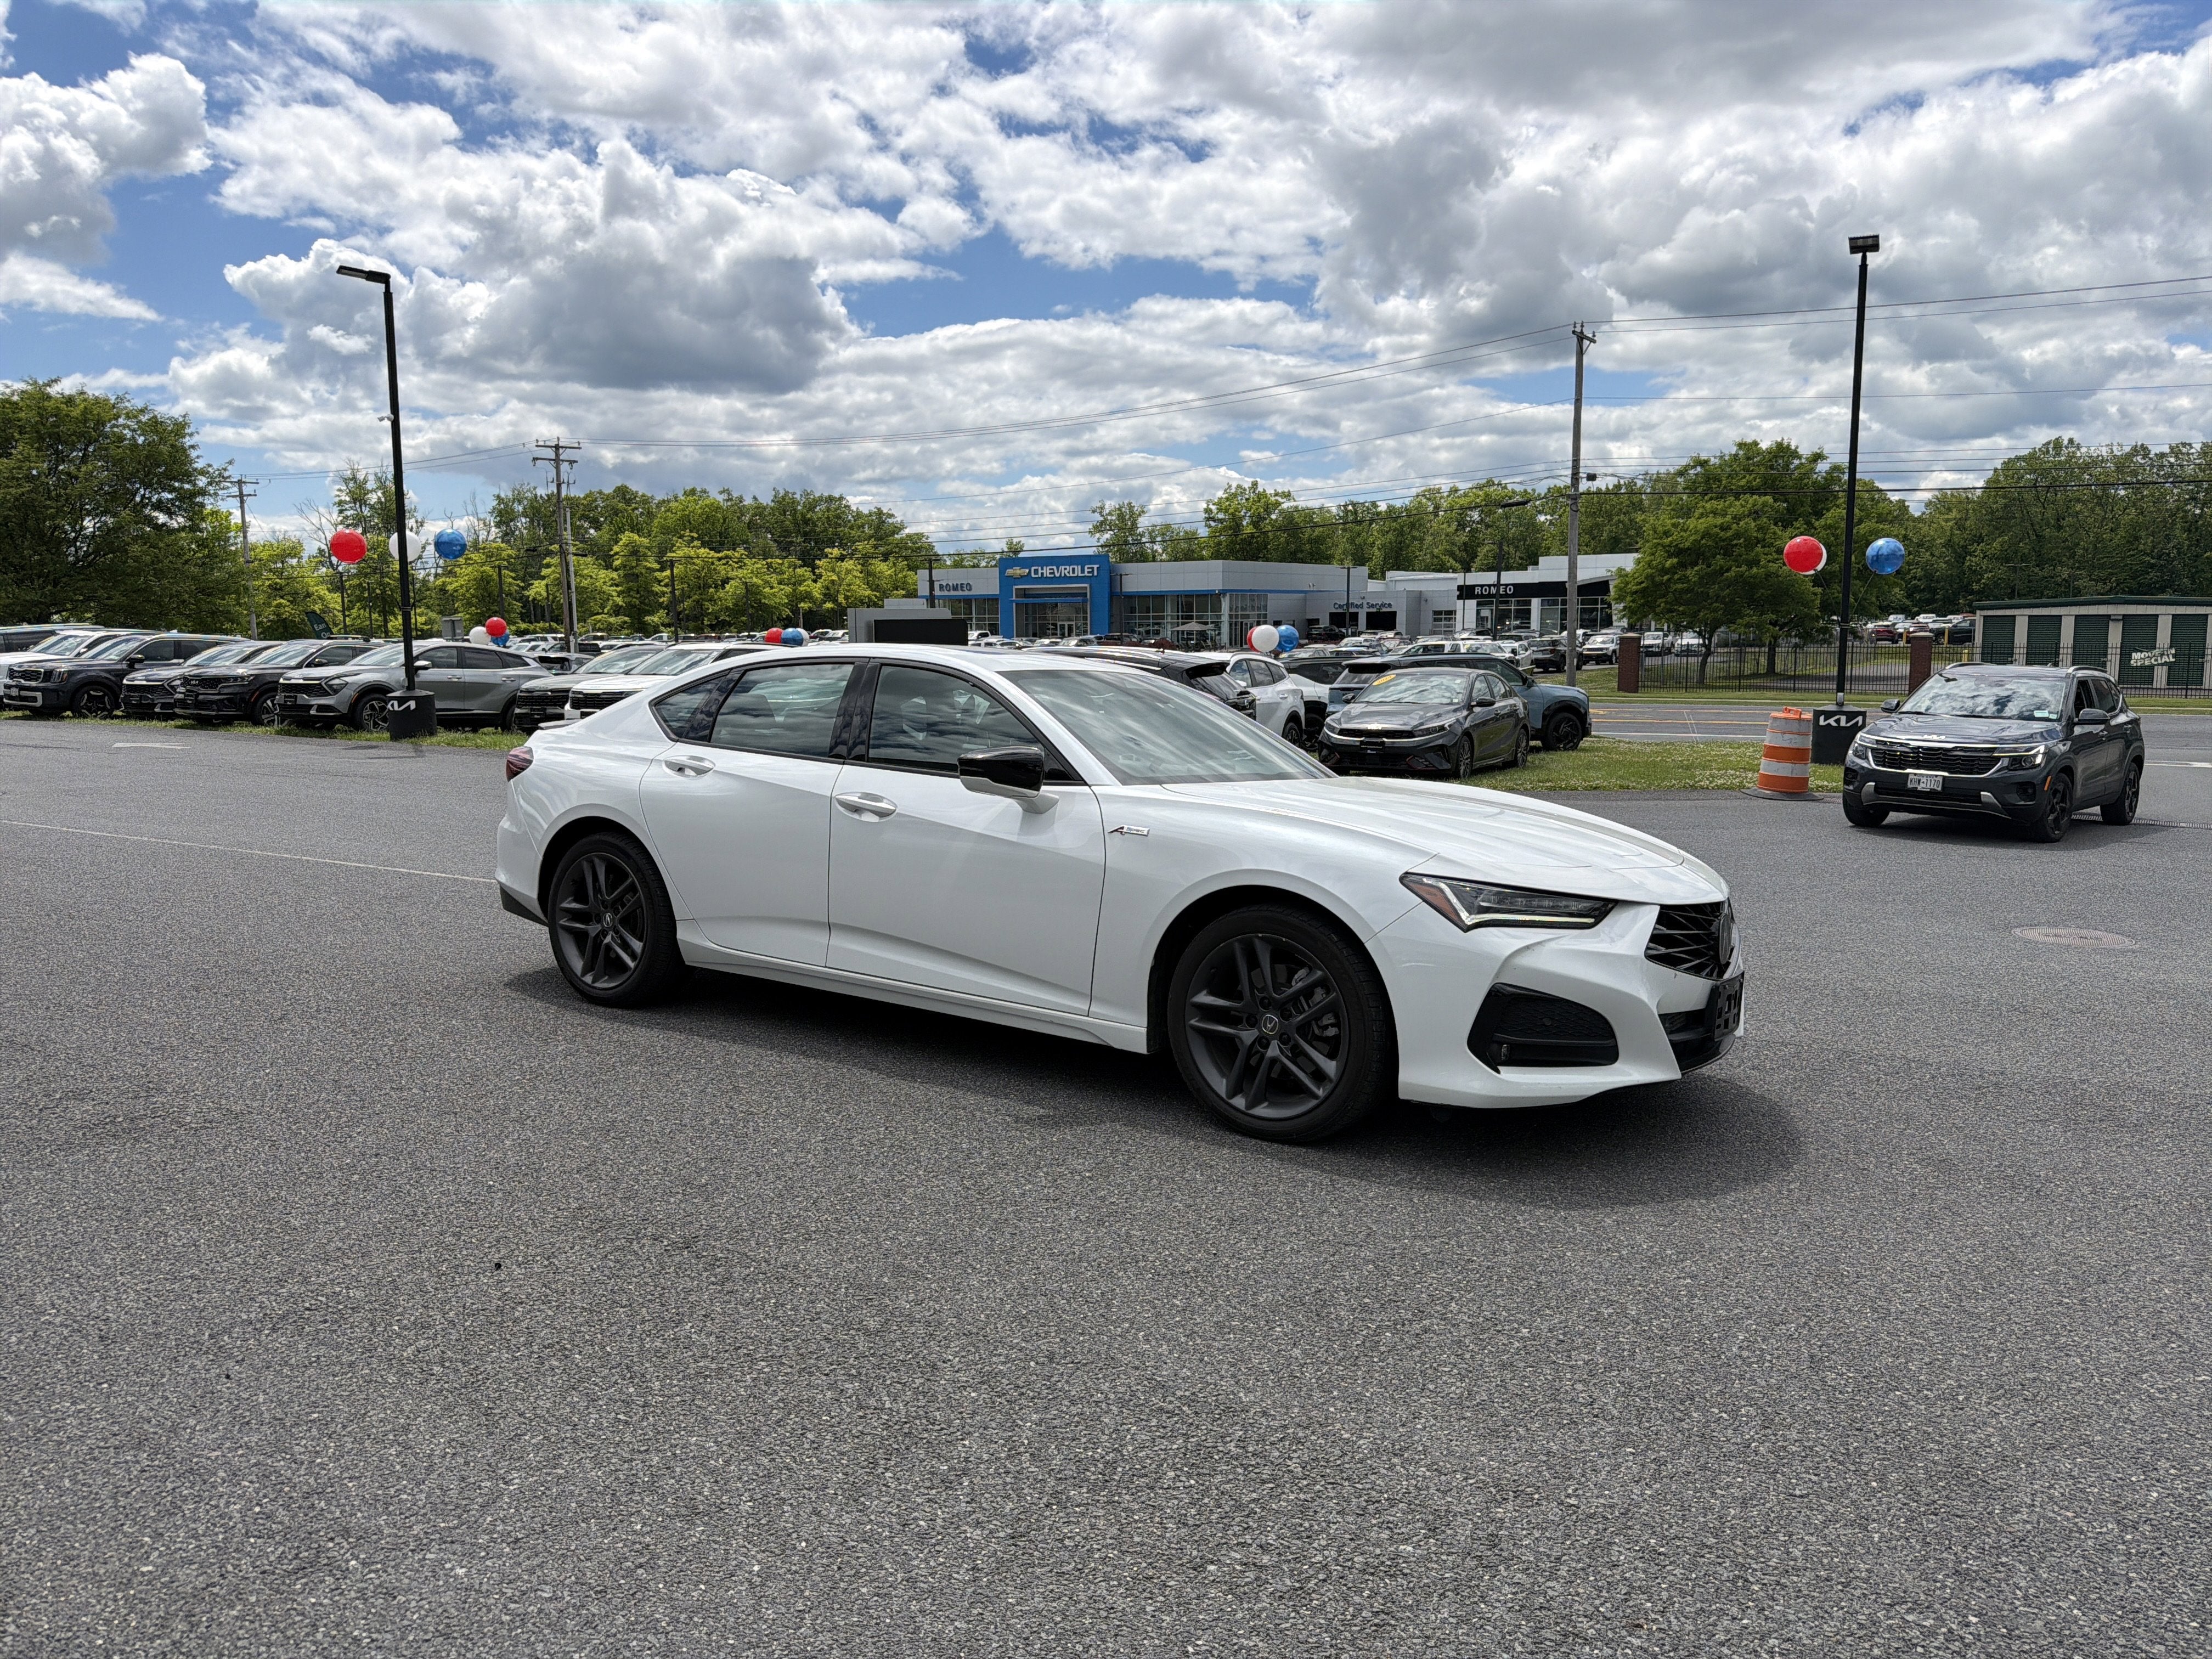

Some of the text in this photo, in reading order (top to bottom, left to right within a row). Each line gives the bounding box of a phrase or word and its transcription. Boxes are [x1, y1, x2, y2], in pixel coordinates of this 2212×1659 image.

[1031, 565, 1099, 578] CHEVROLET
[939, 583, 972, 592] ROMEO
[1475, 585, 1514, 595] ROMEO
[2131, 648, 2175, 659] MOVE-IN
[2130, 654, 2176, 667] SPECIAL
[1819, 715, 1863, 727] KIA
